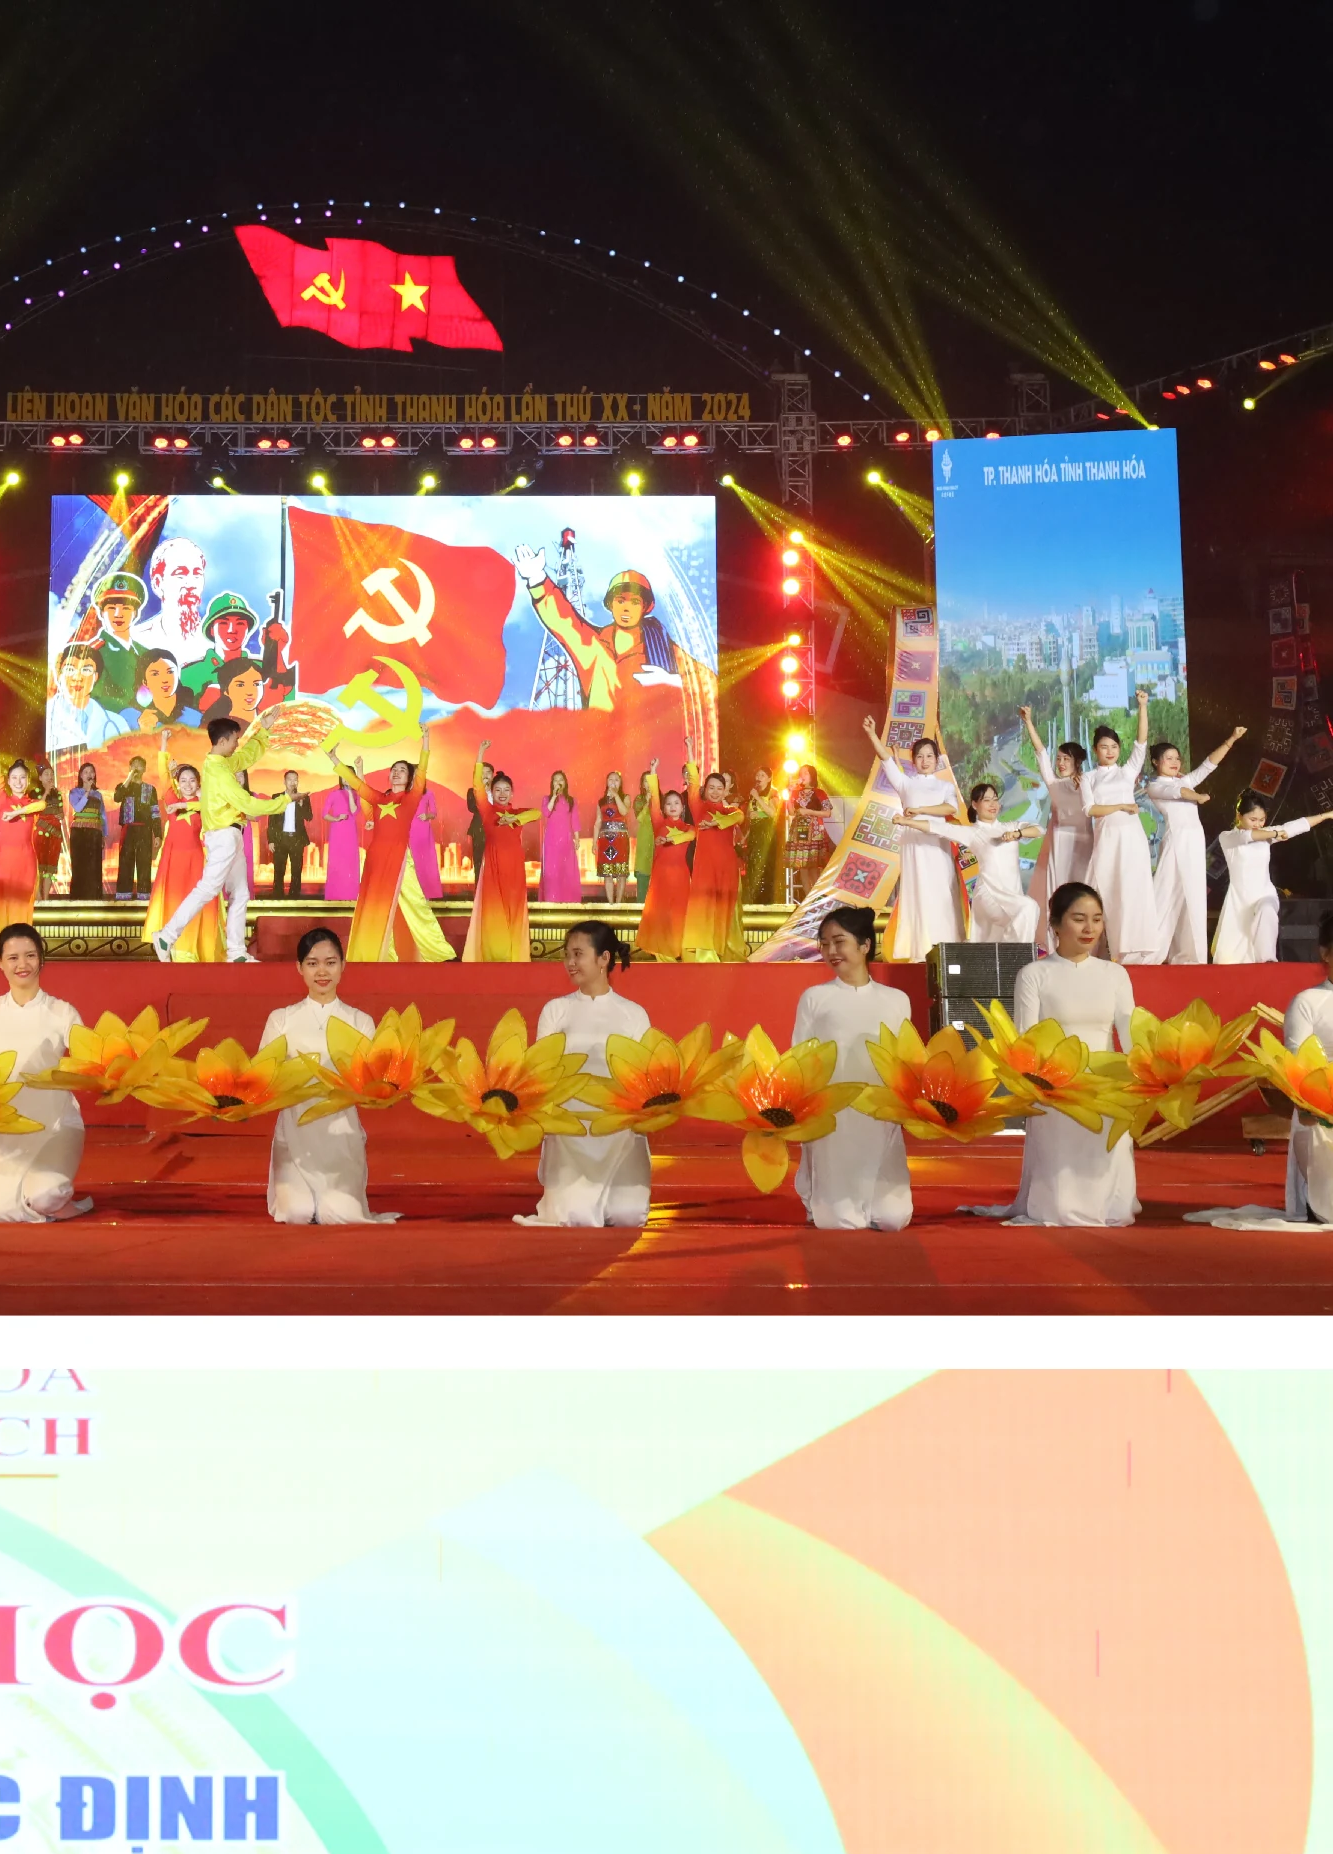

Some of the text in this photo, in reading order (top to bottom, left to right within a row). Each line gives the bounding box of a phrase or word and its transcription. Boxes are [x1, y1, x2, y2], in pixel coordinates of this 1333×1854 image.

[7, 386, 45, 422] LIÊN
[53, 392, 109, 421] HOAN
[116, 386, 155, 422] VĂN
[162, 386, 202, 422] HÓA
[209, 386, 244, 422] CÁC
[252, 388, 292, 422] DÂN
[299, 388, 337, 427] TỘC
[395, 393, 456, 422] THANH
[465, 387, 504, 422] HÓA
[601, 393, 629, 421] XX
[647, 386, 692, 421] NĂM
[702, 392, 750, 421] 2024
[983, 455, 1146, 485] TP. THANH HÓA TỈNH THANH HÓA
[56, 1775, 280, 1854] ĐỊNH
